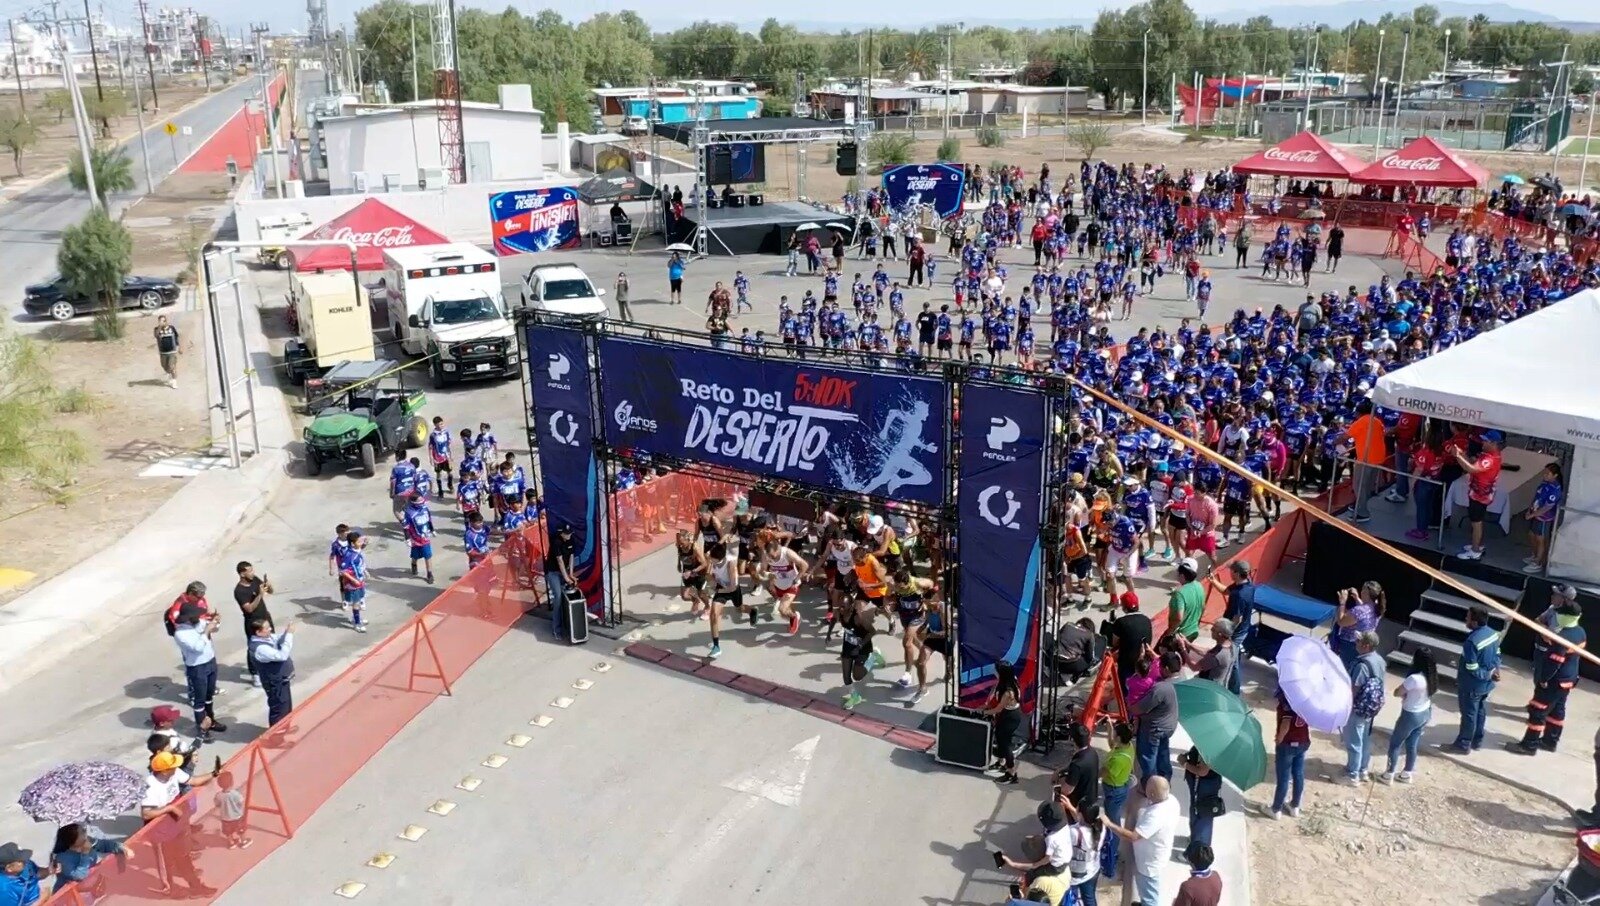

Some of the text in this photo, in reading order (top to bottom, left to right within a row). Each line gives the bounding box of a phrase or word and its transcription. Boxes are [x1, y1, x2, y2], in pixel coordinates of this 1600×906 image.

[1264, 147, 1321, 163] Coca-Cola
[1382, 155, 1445, 171] Coca-Cola
[333, 225, 414, 247] Coca-Cola
[329, 306, 353, 314] KOHLER
[680, 378, 783, 412] Reto Del
